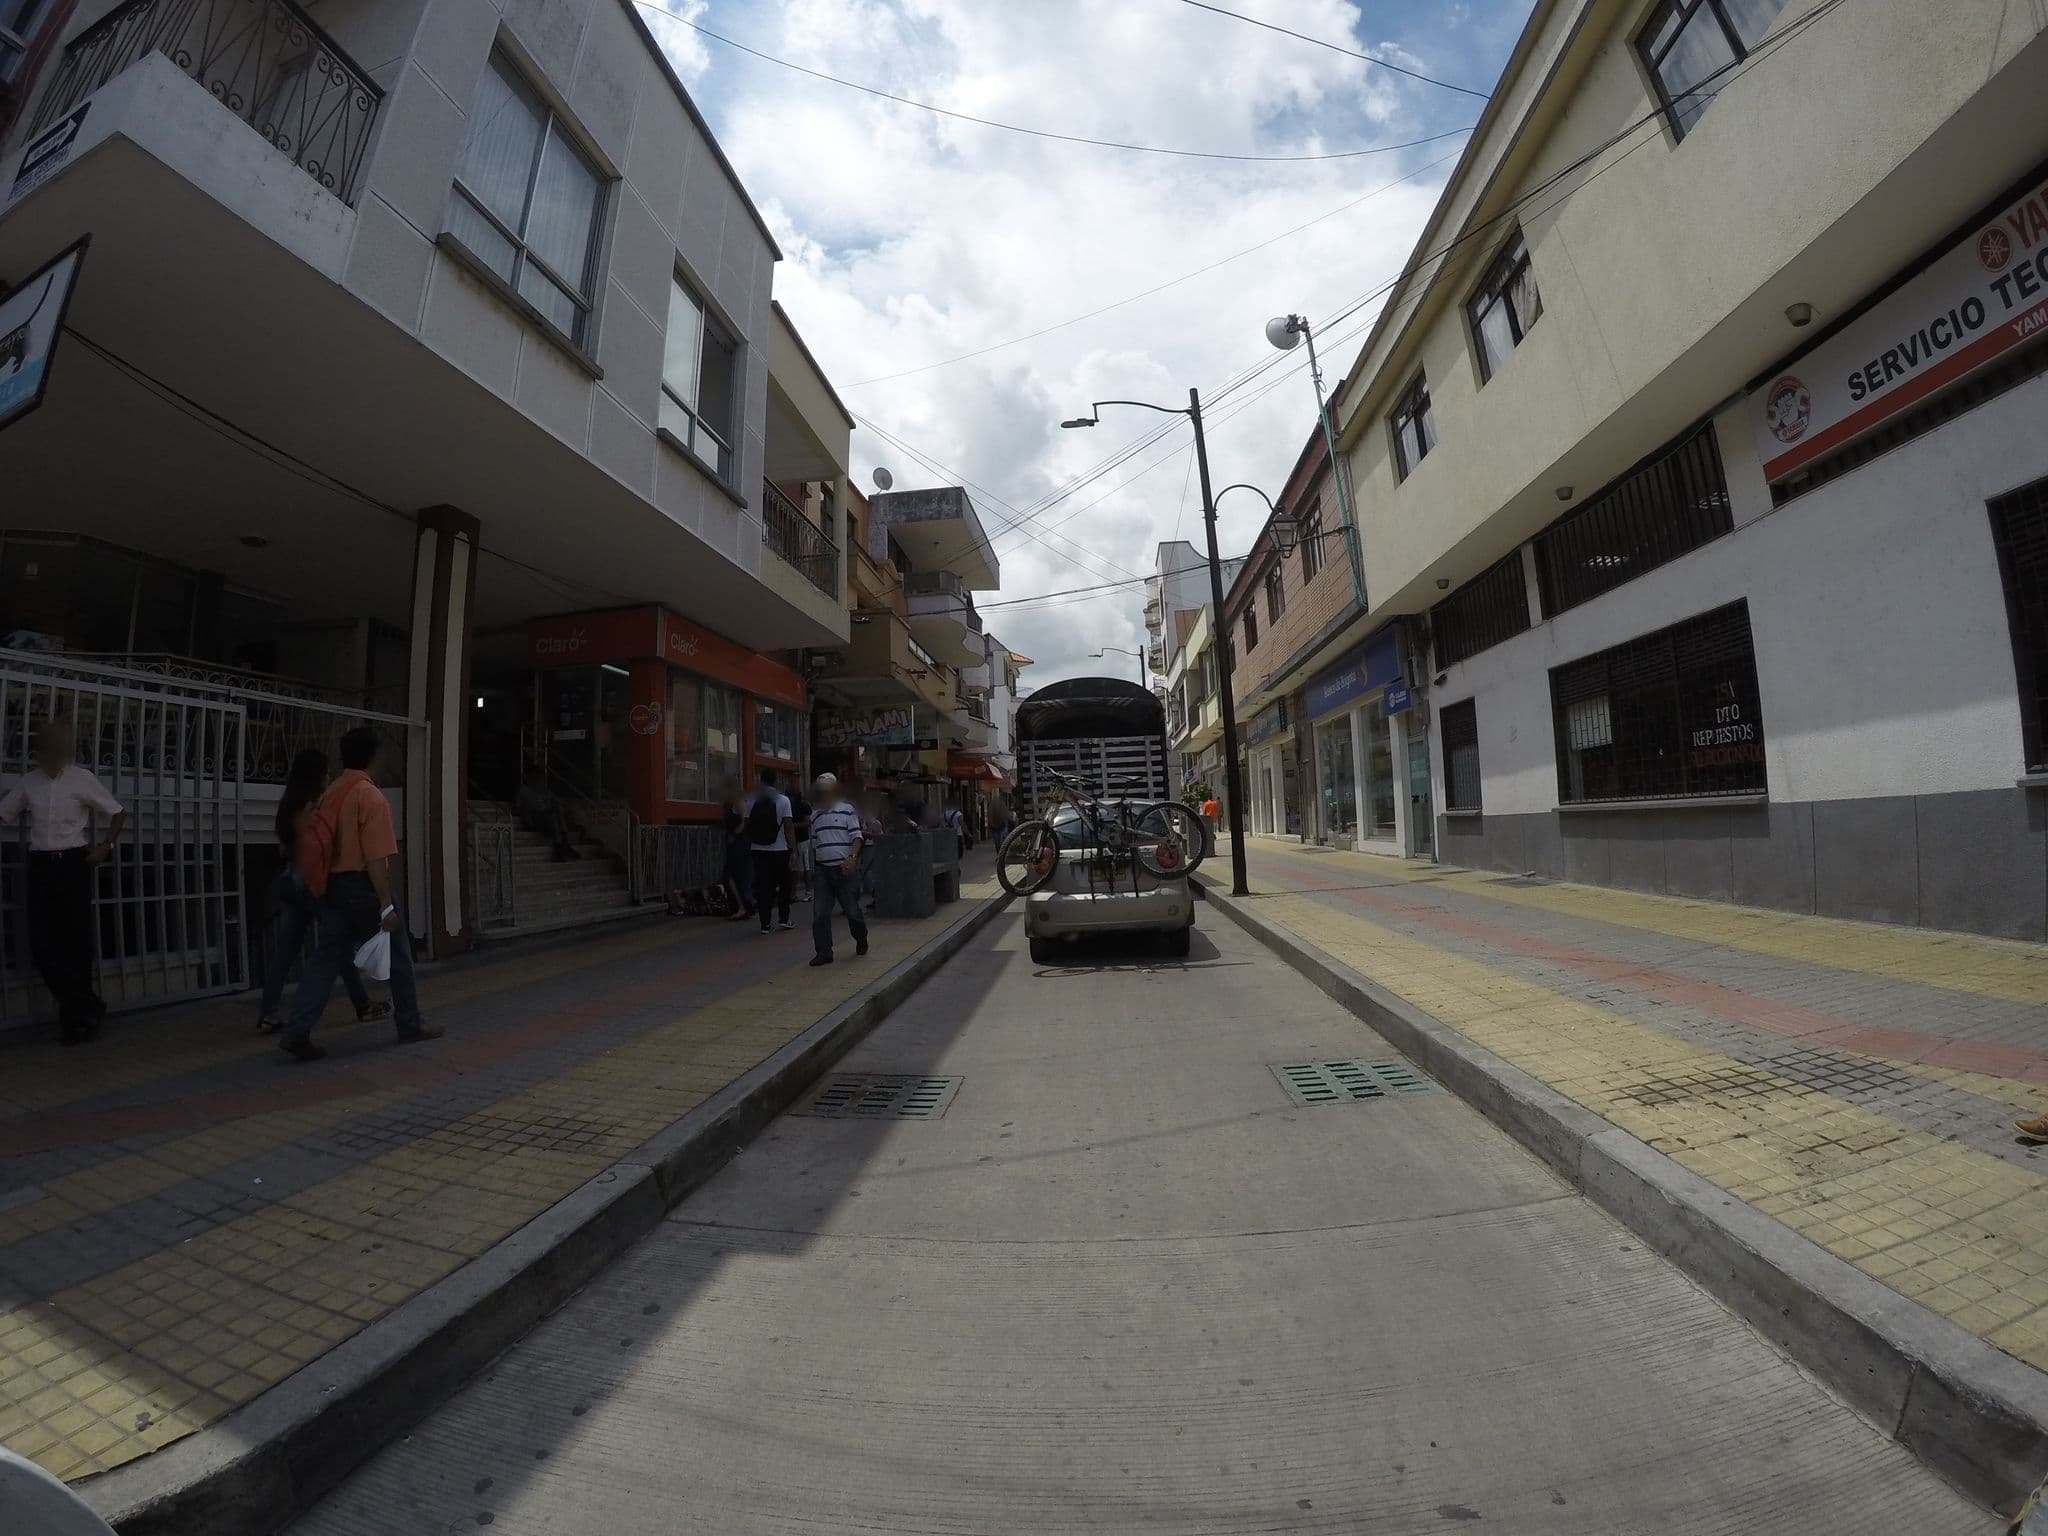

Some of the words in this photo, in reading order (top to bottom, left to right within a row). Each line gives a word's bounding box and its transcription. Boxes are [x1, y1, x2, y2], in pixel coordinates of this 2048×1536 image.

[2006, 187, 2048, 249] YA
[1847, 296, 1986, 402] SERVICIO
[536, 637, 580, 654] Claro
[670, 632, 695, 656] Claro
